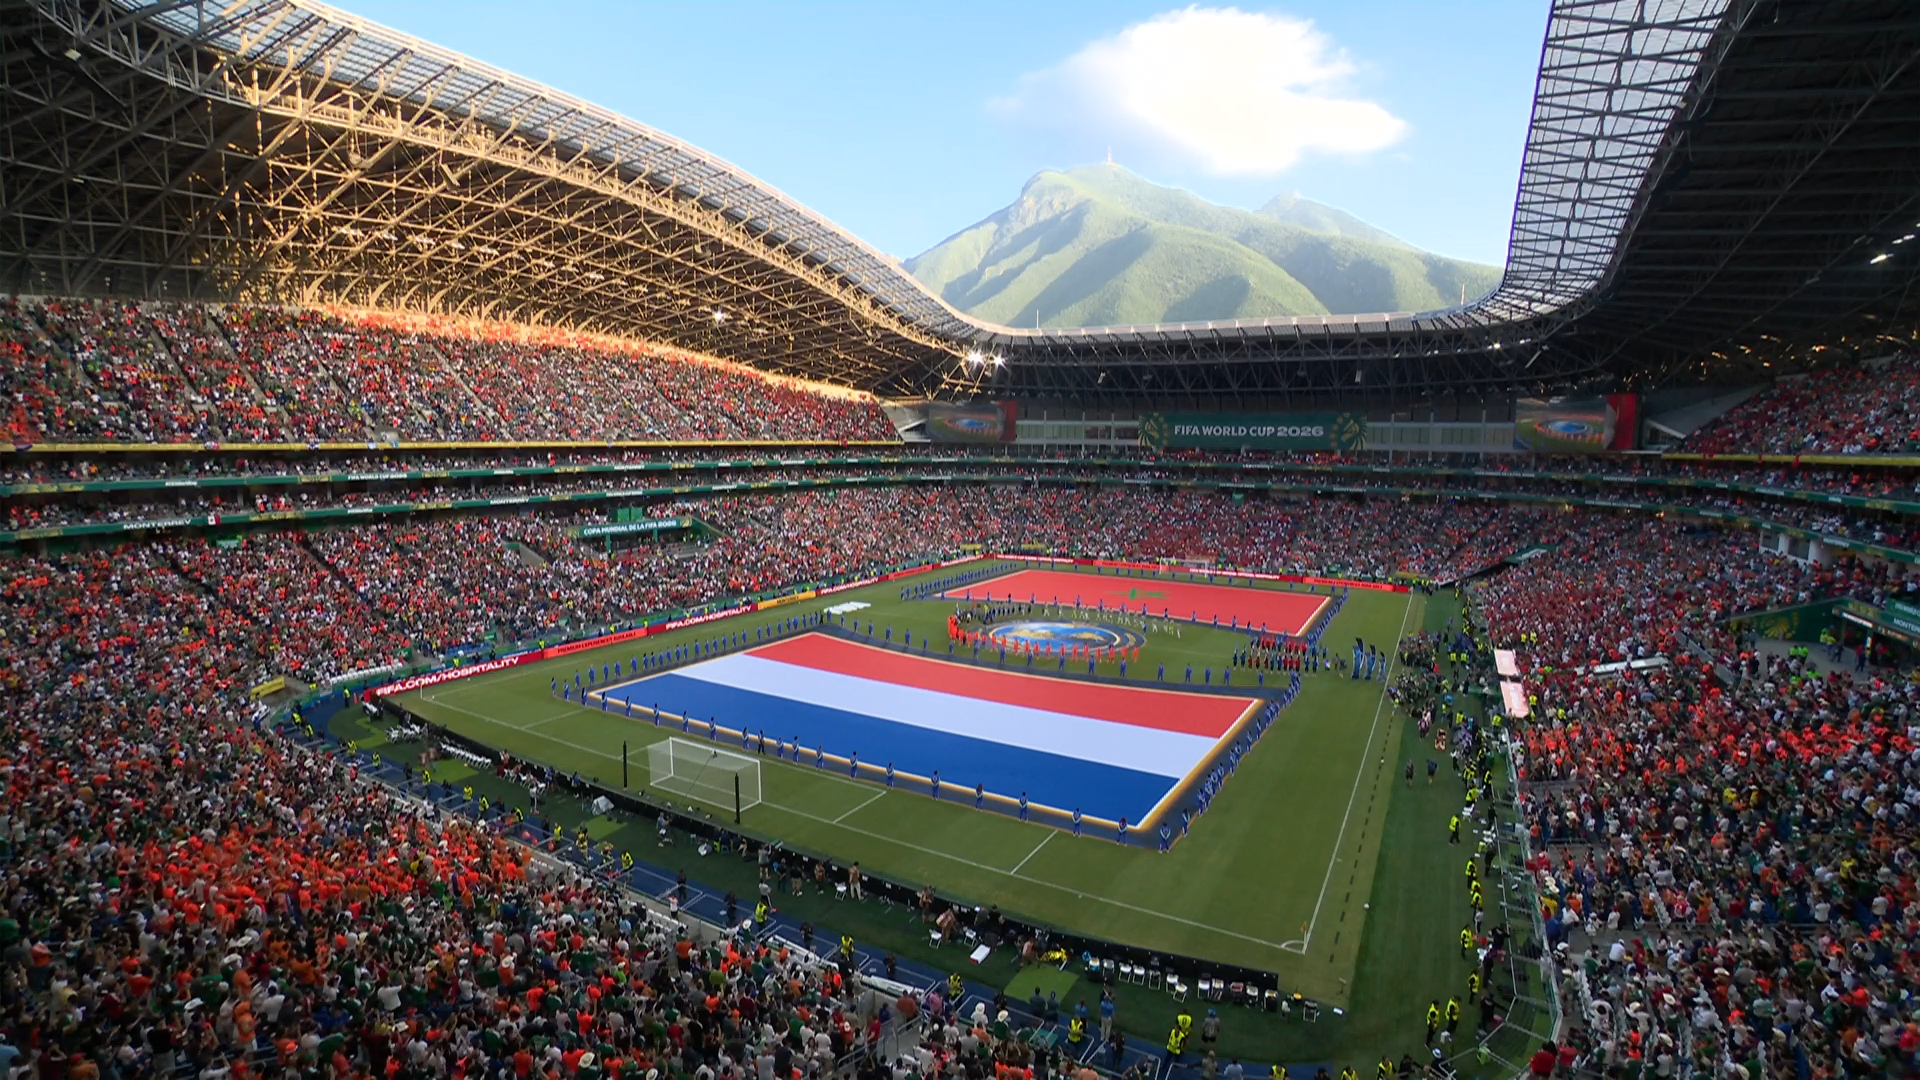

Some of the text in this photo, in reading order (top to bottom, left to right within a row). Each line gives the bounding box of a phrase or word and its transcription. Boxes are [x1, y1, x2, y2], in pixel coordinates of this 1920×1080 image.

[1174, 425, 1324, 437] FIFA WORLD CUP 2026
[123, 519, 192, 530] MONTERREY
[583, 527, 601, 536] COPA
[601, 525, 629, 534] MUNDIAL
[645, 522, 658, 530] FIFA
[820, 576, 879, 595] FIFA.COM/HOSPITALITY
[665, 605, 752, 630] FIFA.COM/HOSPITALITY
[557, 643, 581, 654] PREMIUM
[375, 657, 519, 696] FIFA.COM/HOSPITALITY
